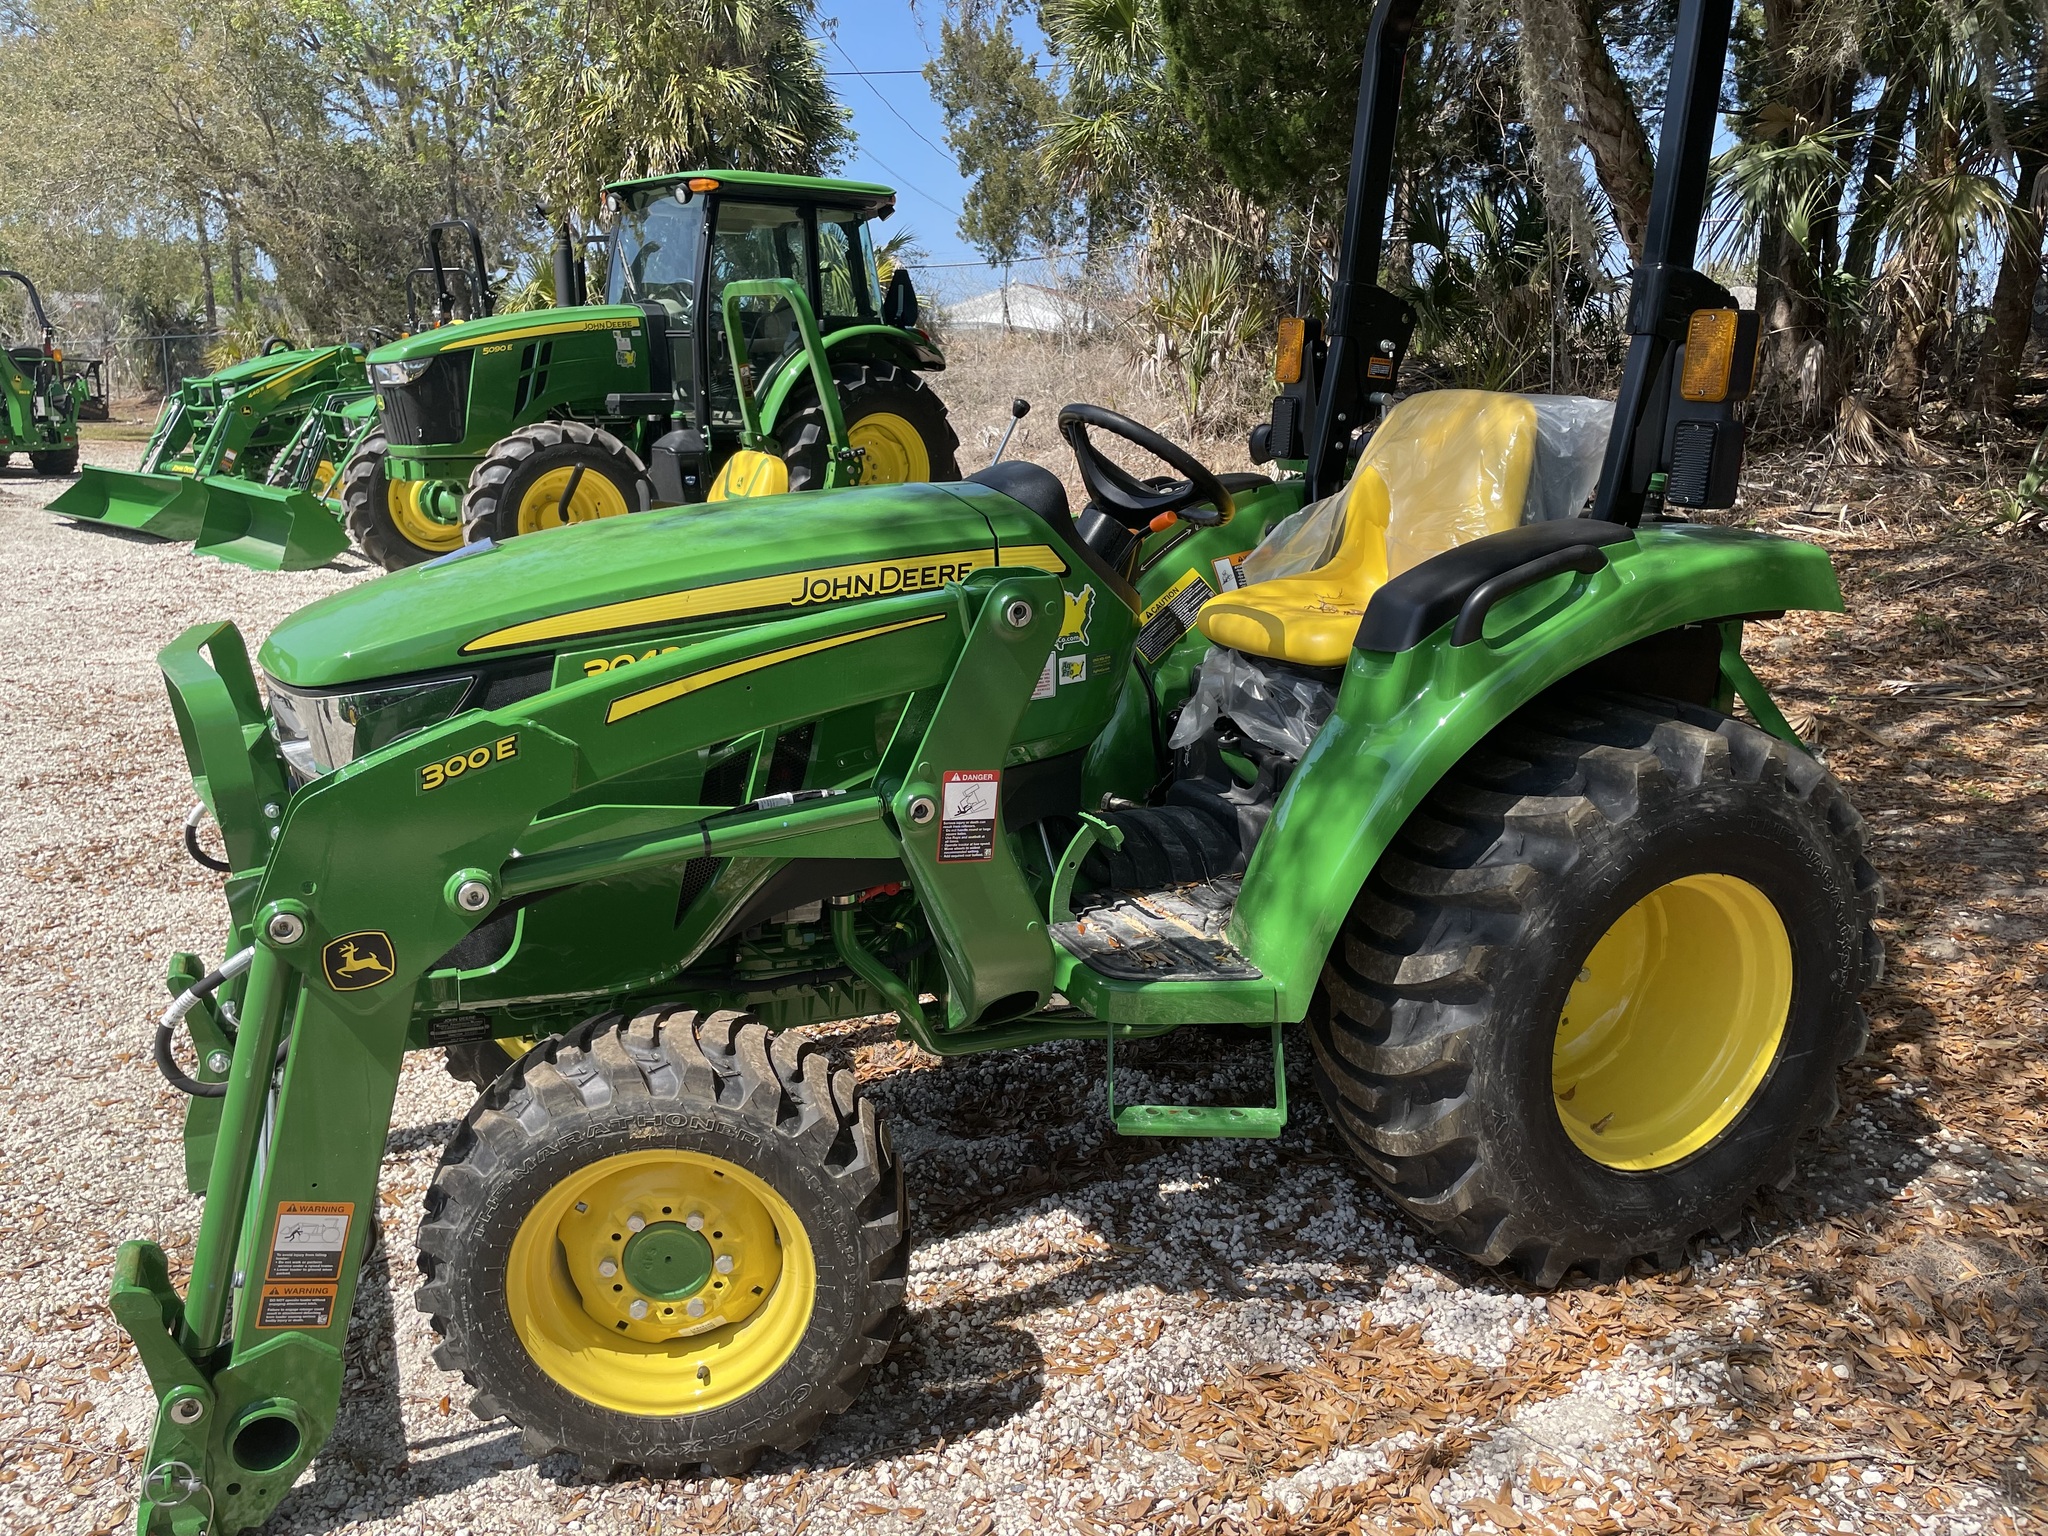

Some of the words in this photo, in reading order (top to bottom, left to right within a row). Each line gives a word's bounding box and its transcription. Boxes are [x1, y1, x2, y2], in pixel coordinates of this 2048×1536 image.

[583, 322, 605, 332] JOHN
[605, 320, 633, 330] DEERE
[483, 345, 507, 356] 5090
[507, 343, 514, 351] E
[791, 573, 874, 606] JOHN
[878, 562, 973, 592] DEERE
[1150, 586, 1180, 614] CAUTION
[421, 746, 492, 791] 300
[495, 735, 518, 762] E
[962, 773, 994, 781] DANGER
[468, 1181, 512, 1240] THE
[511, 1112, 762, 1182] MARATHONER
[299, 1205, 345, 1214] WARNING
[283, 1287, 329, 1295] WARNING
[645, 1382, 813, 1456] GALAXY
